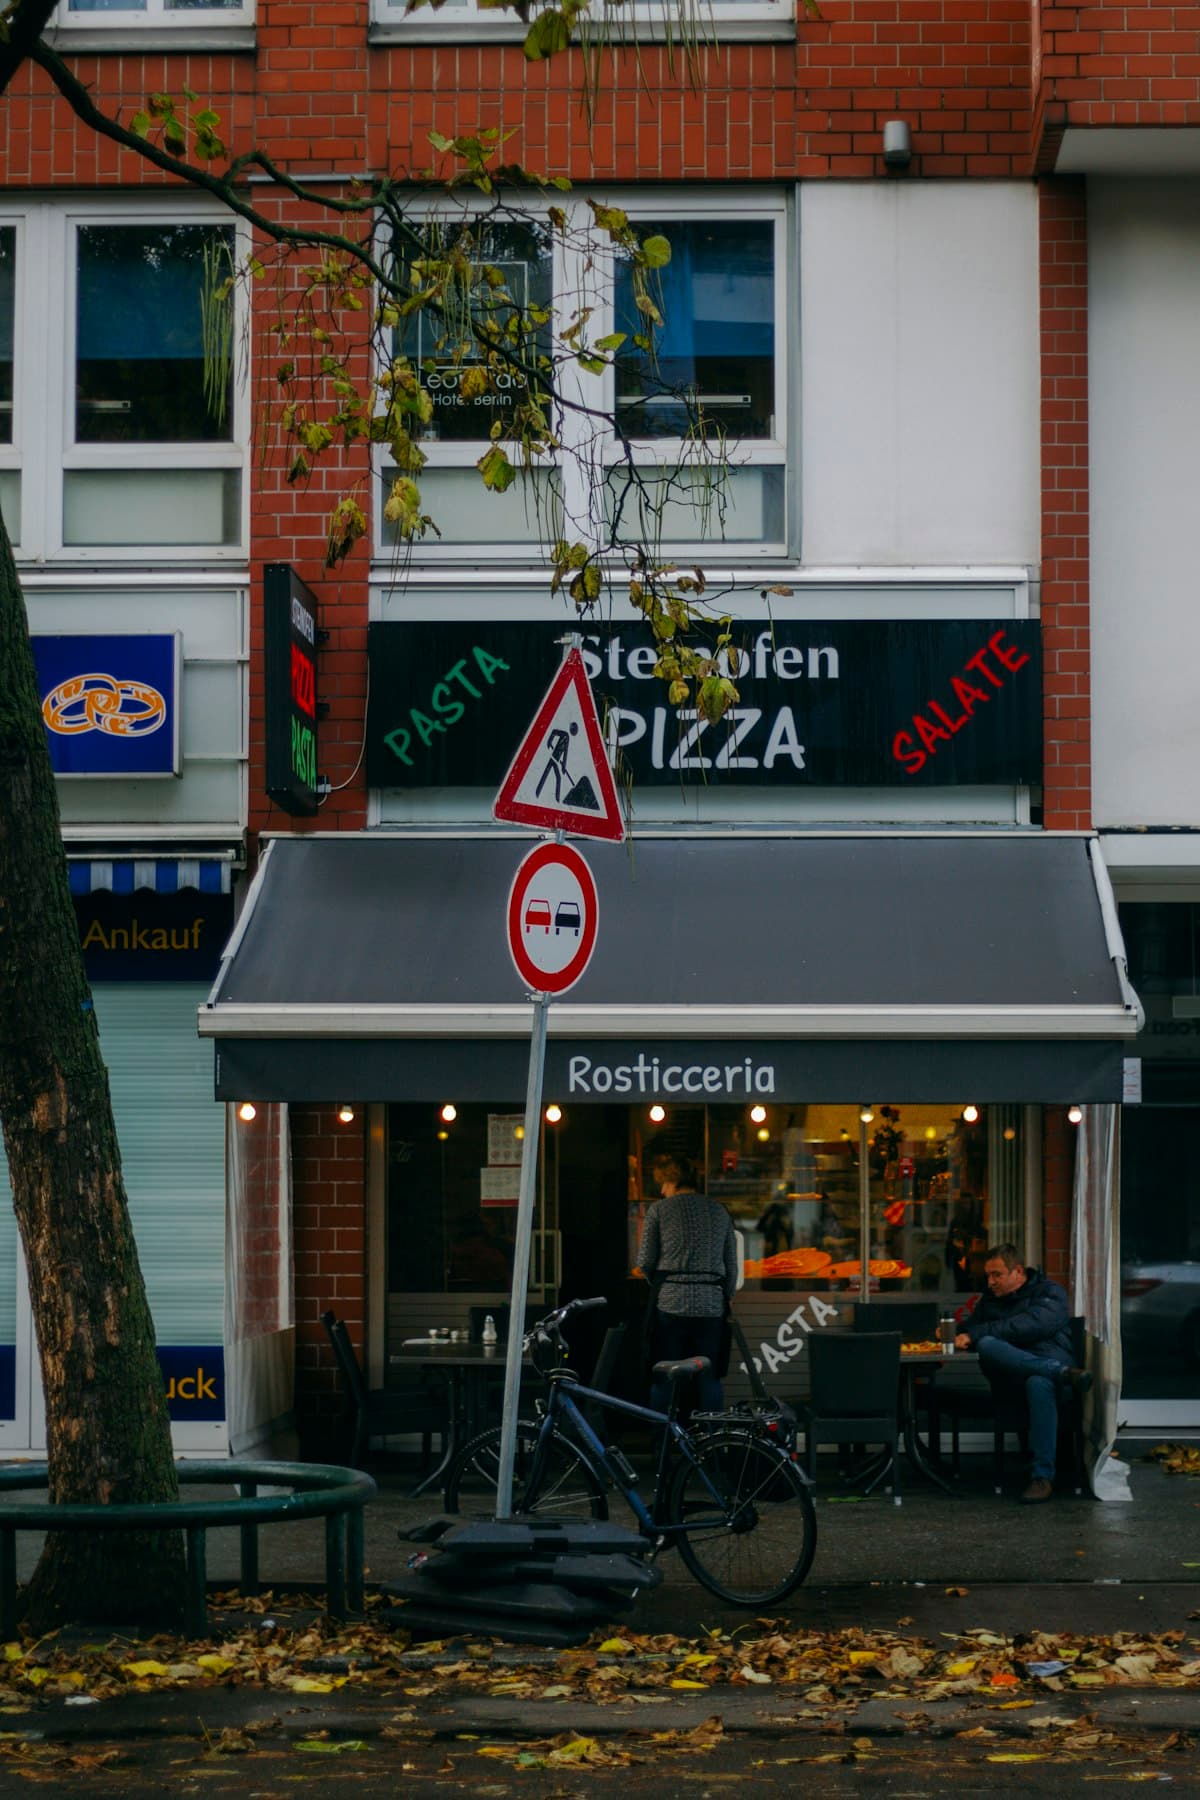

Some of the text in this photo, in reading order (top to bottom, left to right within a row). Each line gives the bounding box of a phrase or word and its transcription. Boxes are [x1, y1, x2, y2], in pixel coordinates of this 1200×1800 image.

[432, 392, 469, 406] Hote
[383, 645, 511, 767] PASTA
[892, 630, 1030, 773] SALATE
[291, 714, 317, 792] PASTA
[606, 705, 806, 770] PIZZA
[80, 917, 206, 950] Ankauf
[568, 1052, 776, 1094] Rosticceria
